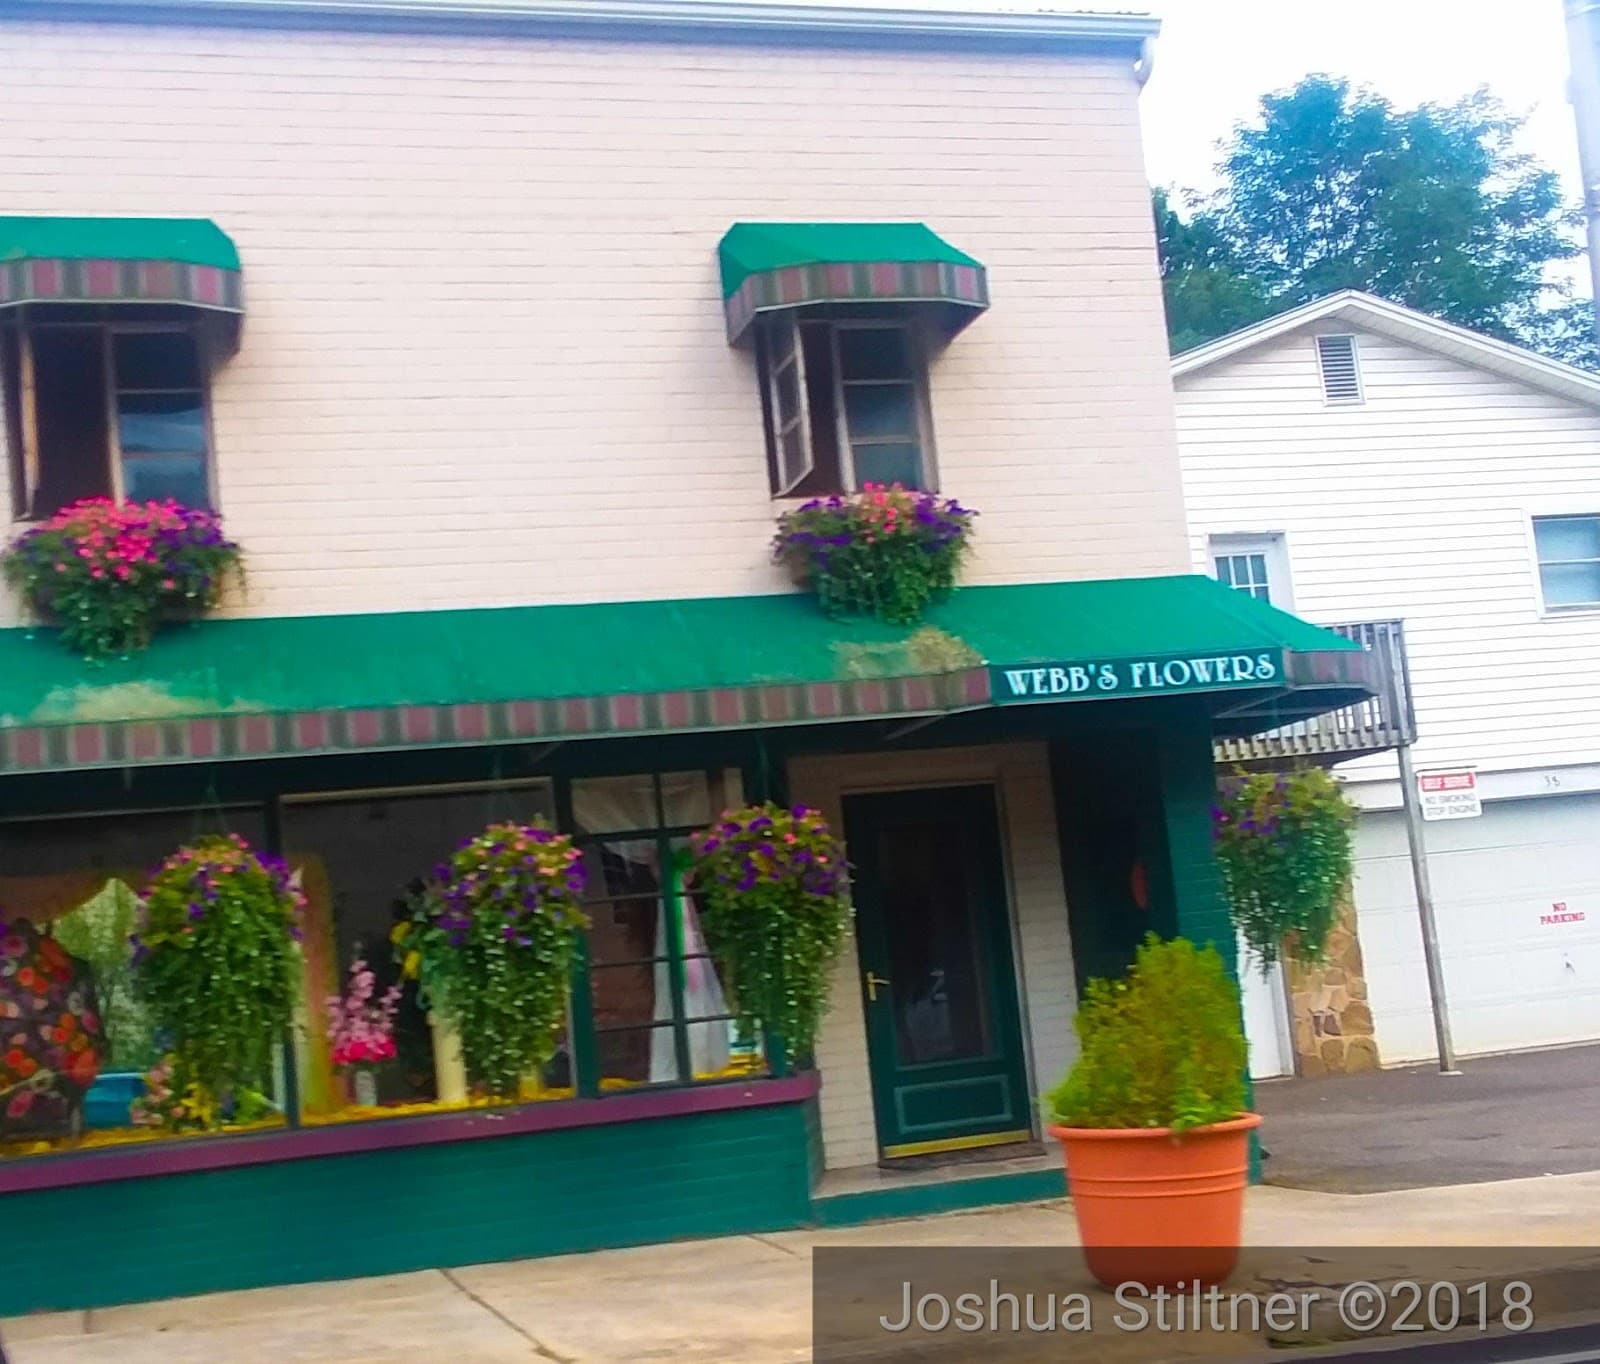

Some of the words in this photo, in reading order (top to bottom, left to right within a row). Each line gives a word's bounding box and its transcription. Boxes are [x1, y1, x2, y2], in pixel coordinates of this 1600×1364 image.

[1004, 663, 1118, 696] WEBB'S
[1129, 653, 1276, 688] FLOWERS
[1552, 902, 1567, 912] NO
[1540, 912, 1585, 925] PARKING
